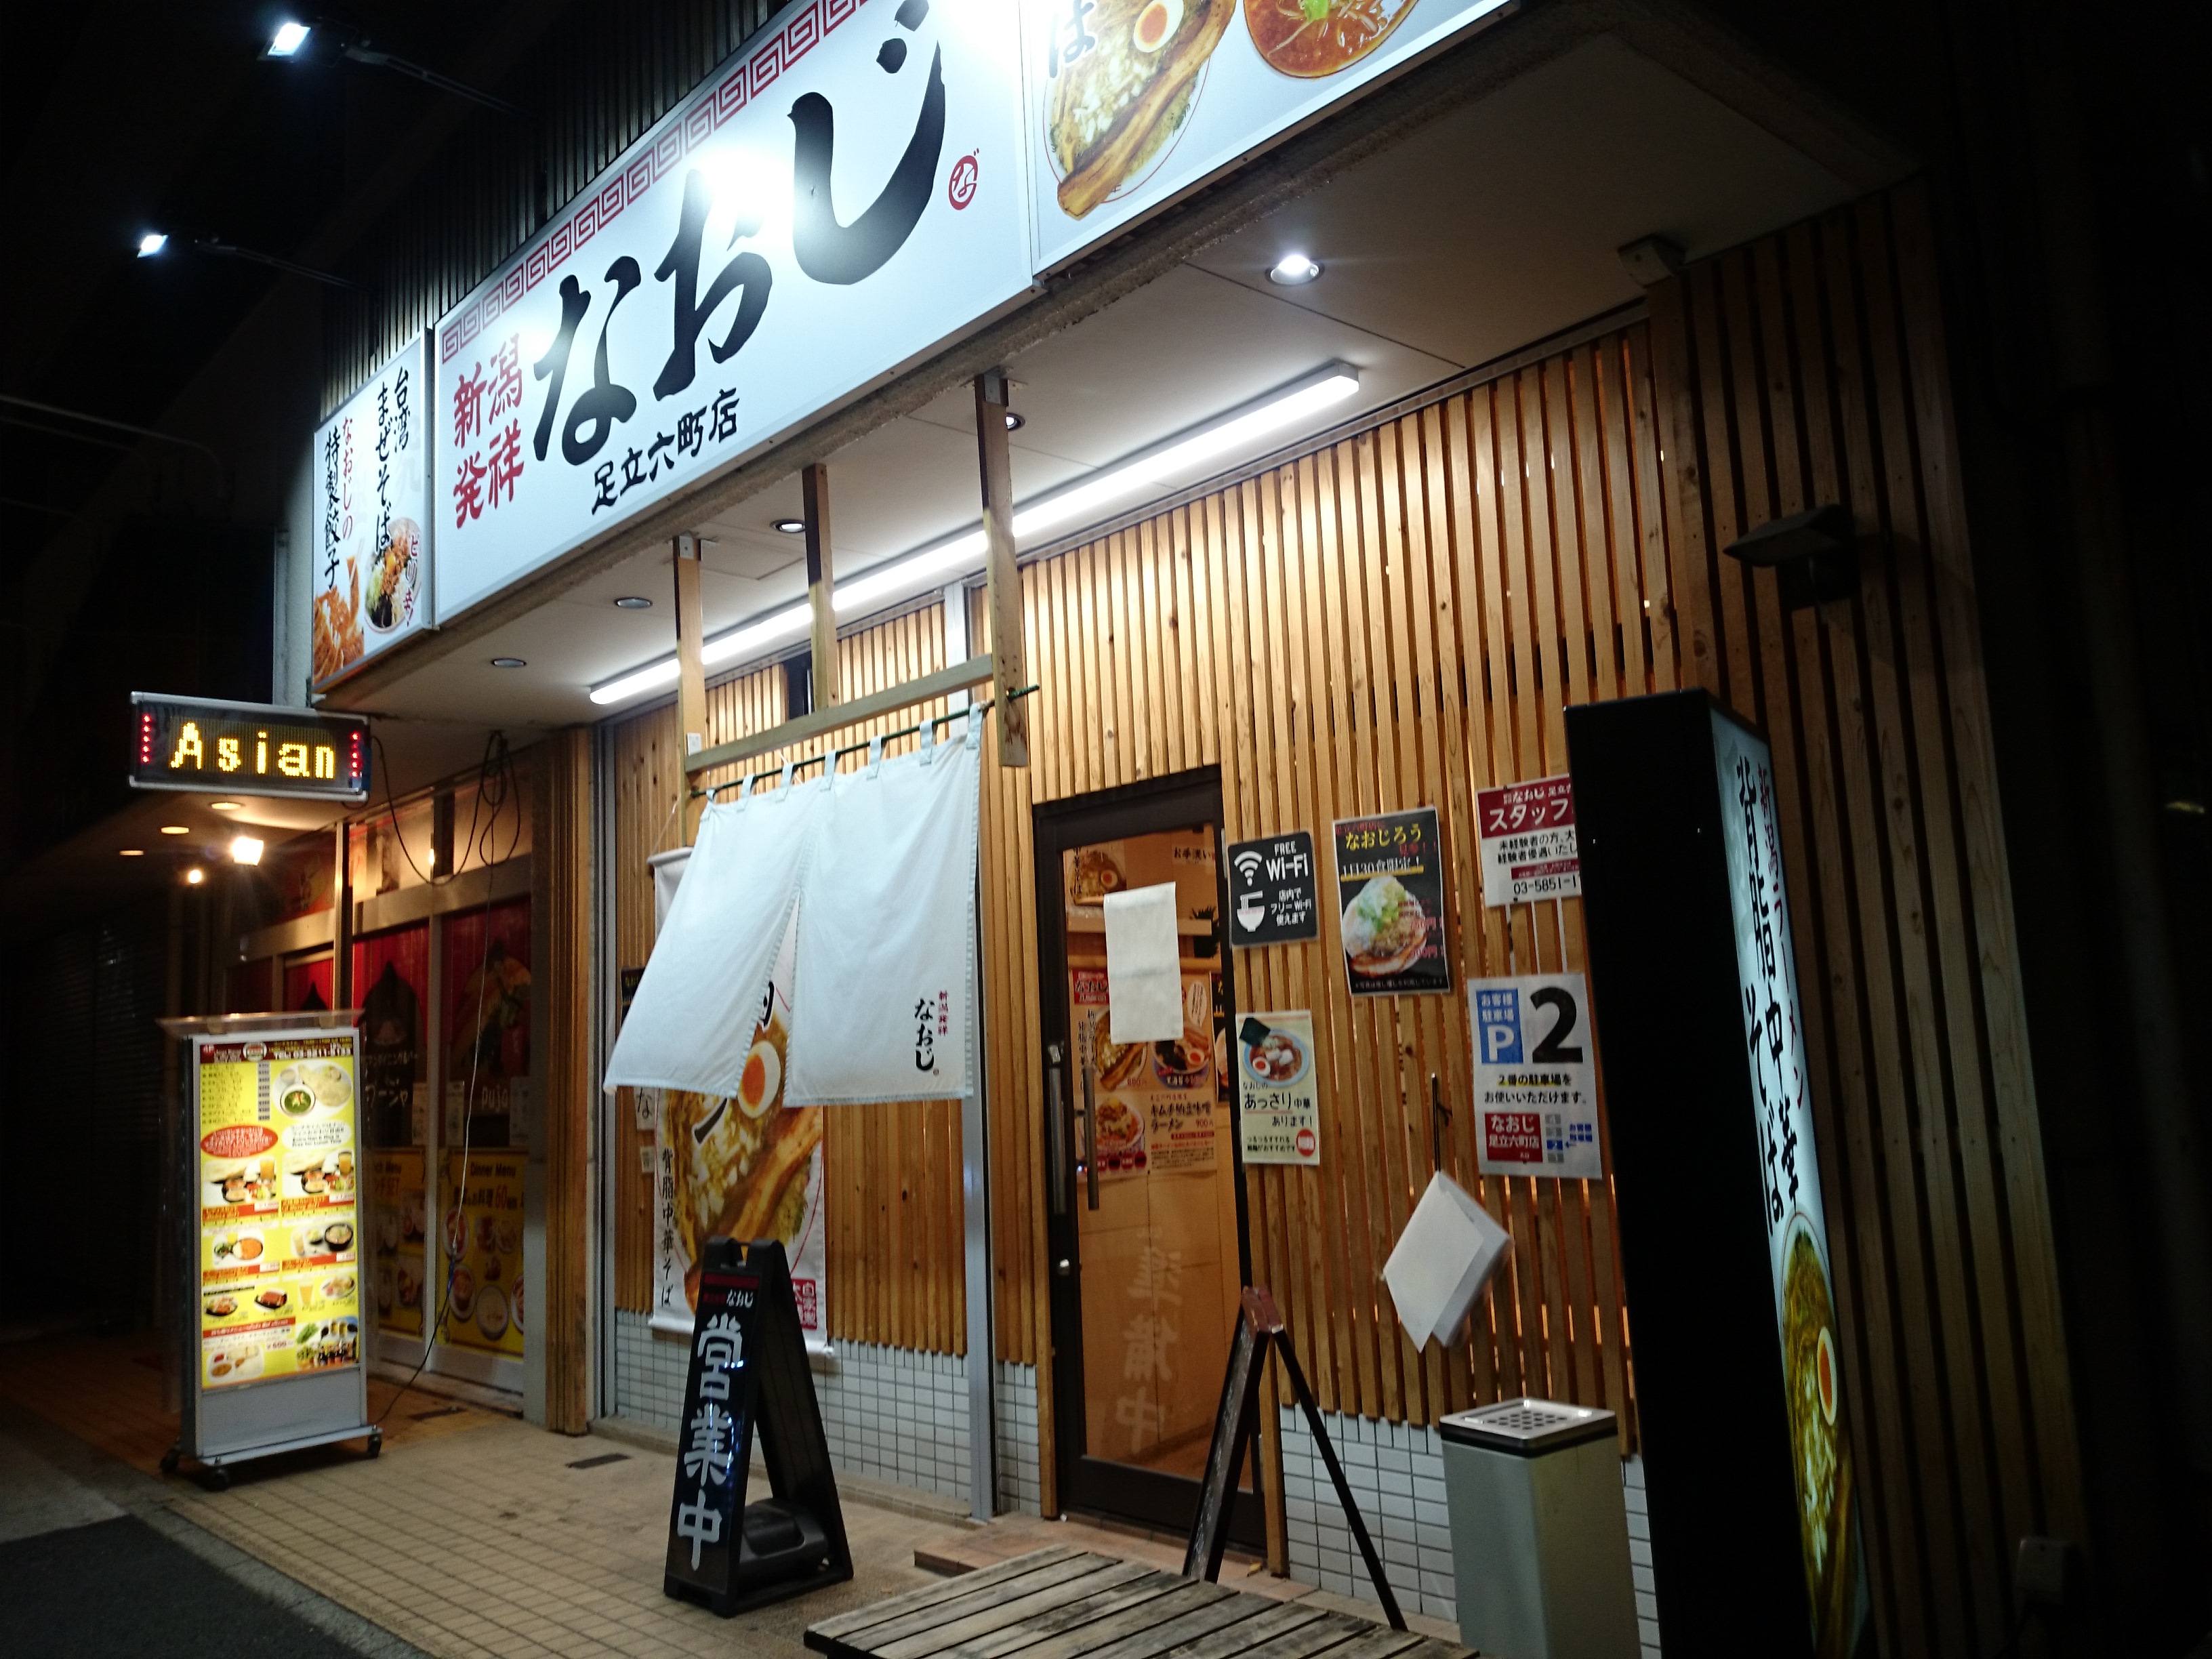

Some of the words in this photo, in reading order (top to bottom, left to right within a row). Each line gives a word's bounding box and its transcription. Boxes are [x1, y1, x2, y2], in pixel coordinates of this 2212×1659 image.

[533, 0, 946, 466] なおじ
[394, 365, 410, 453] 台湾
[453, 333, 524, 449] 新潟
[342, 415, 354, 541] なおじの
[375, 381, 392, 557] まぜそば
[453, 417, 526, 529] 発祥
[592, 387, 741, 516] 足立六町店
[170, 722, 334, 779] Asian
[1274, 840, 1296, 857] FREE
[1345, 823, 1421, 851] なおじろう
[1490, 798, 1568, 832] スタッフ
[914, 998, 935, 1071] なおじ
[1487, 1025, 1515, 1063] P
[1530, 986, 1584, 1063] 2
[1488, 1134, 1539, 1149] 足立六町店
[1490, 1115, 1535, 1134] なおじ
[470, 1162, 492, 1176] Dinner
[495, 1163, 516, 1179] Menu
[726, 1289, 754, 1309] なおじ
[678, 1313, 743, 1572] 営業中
